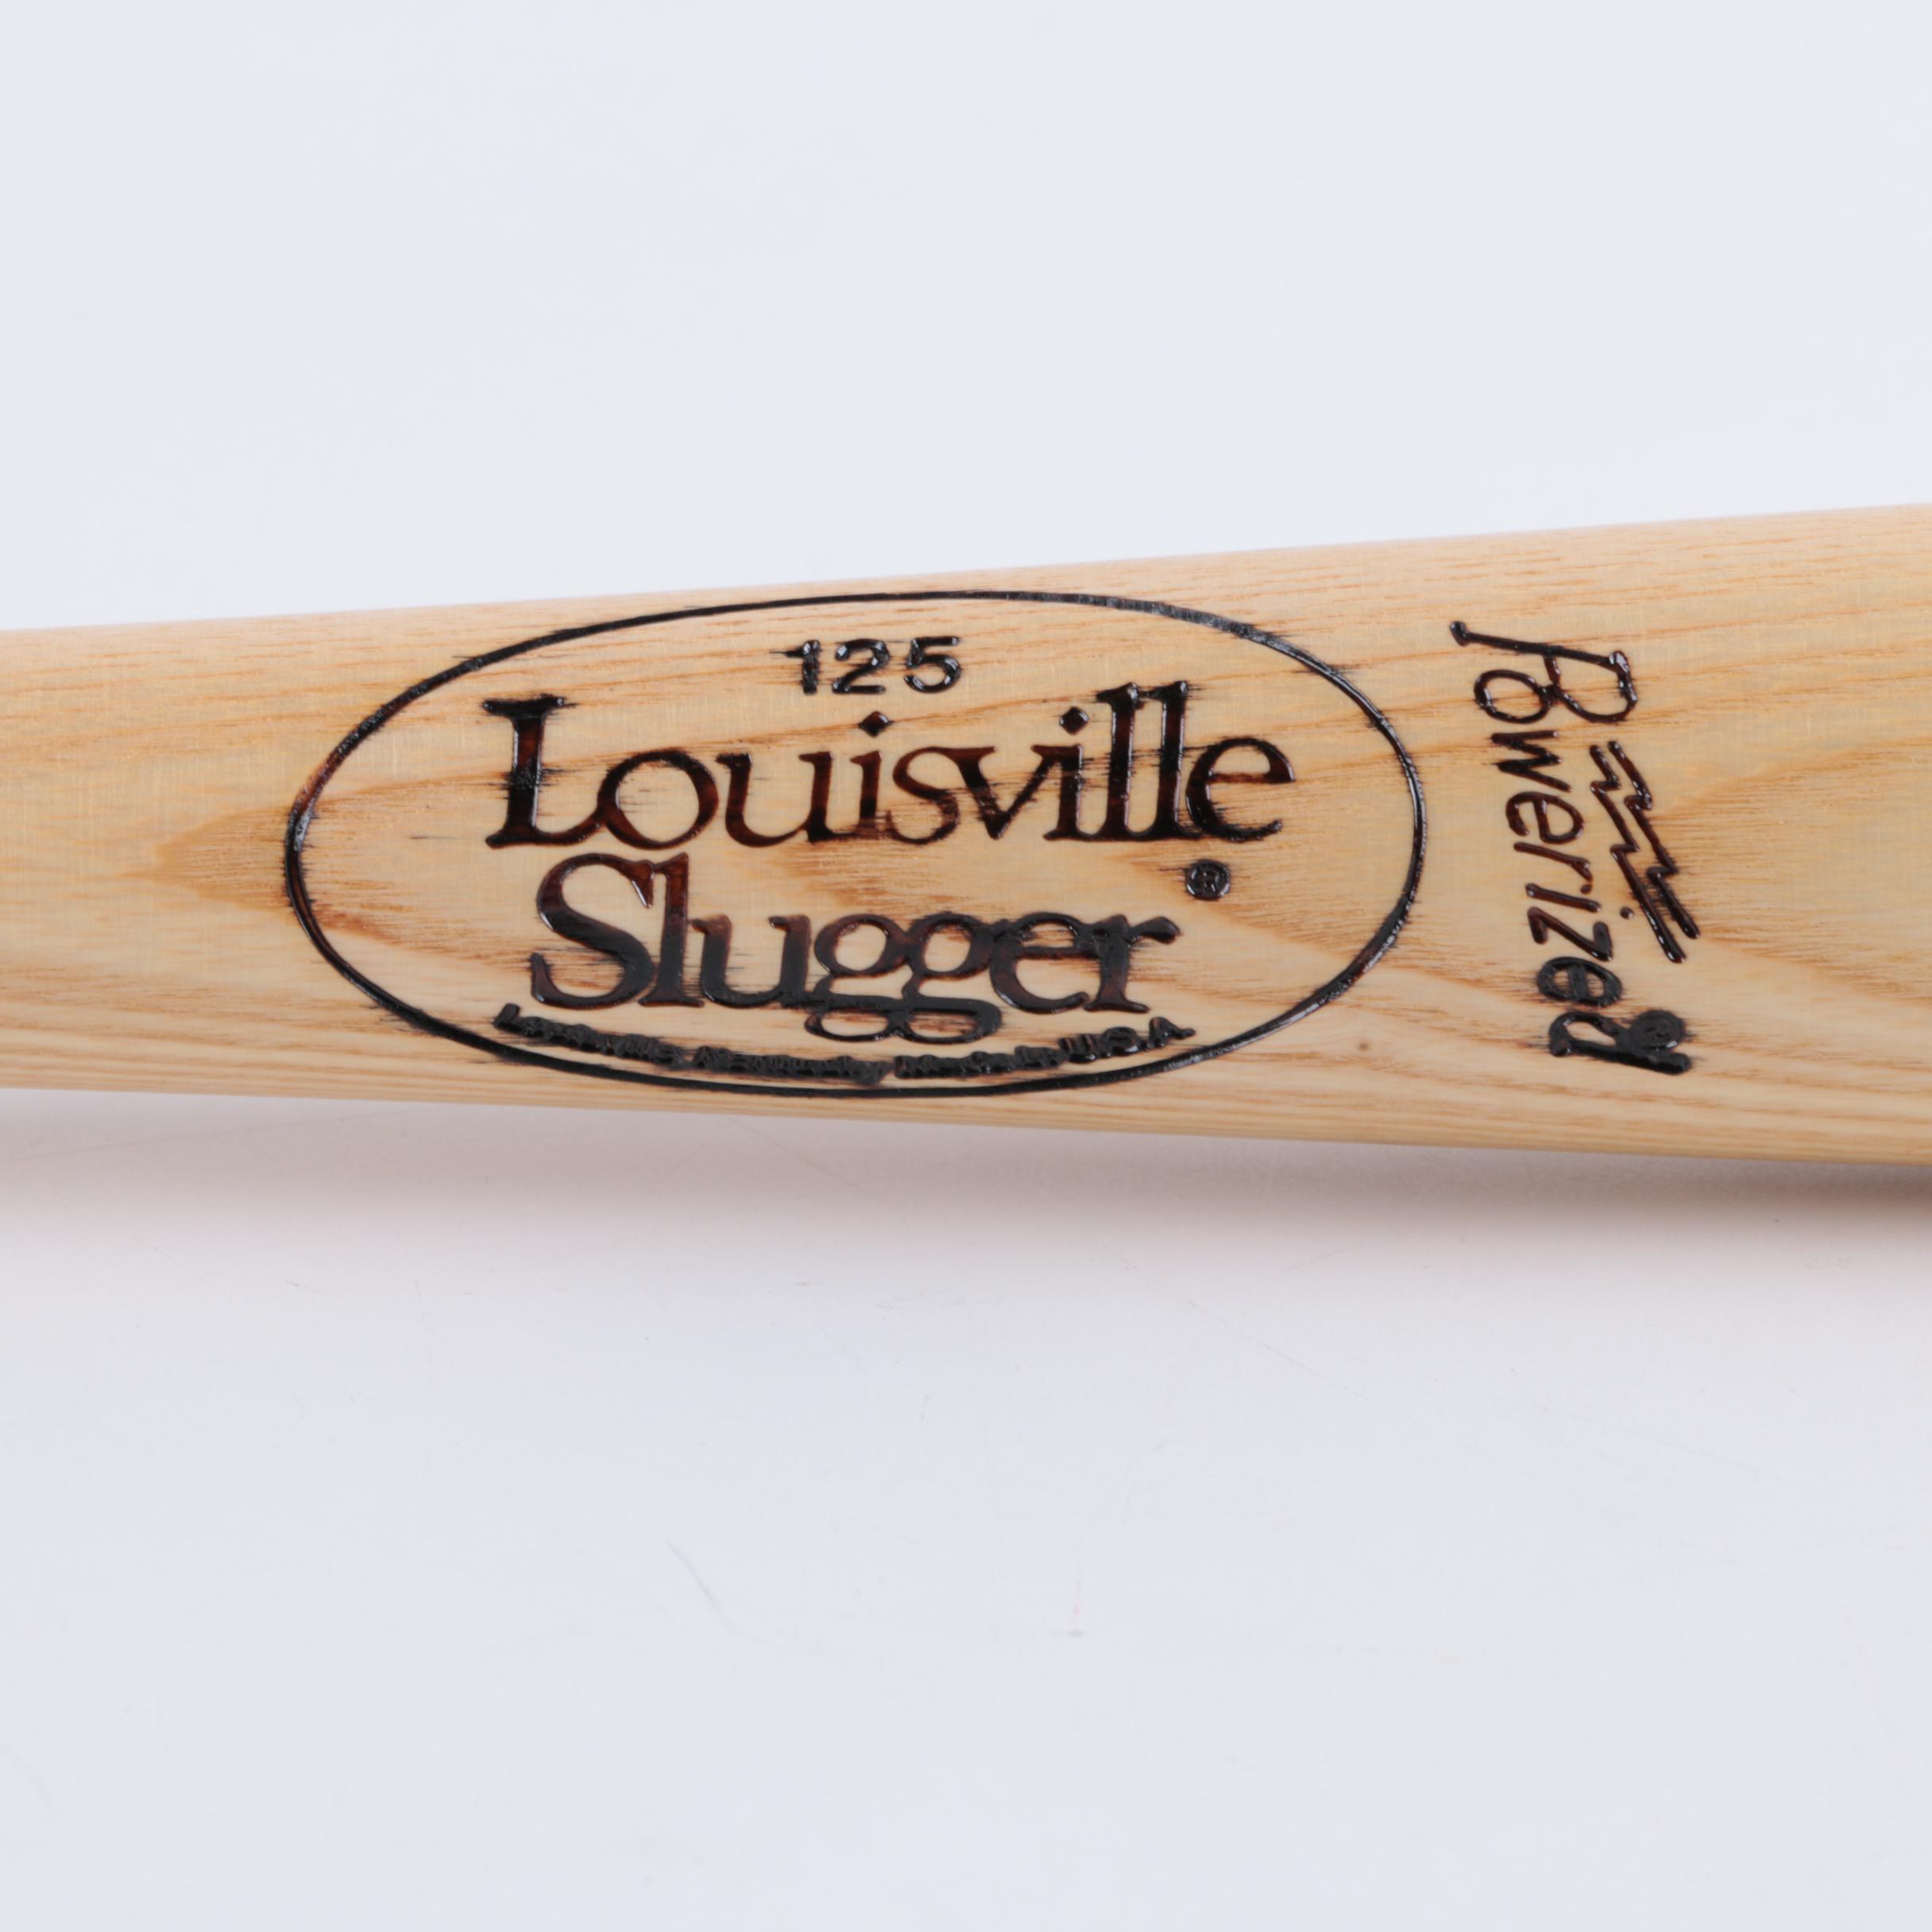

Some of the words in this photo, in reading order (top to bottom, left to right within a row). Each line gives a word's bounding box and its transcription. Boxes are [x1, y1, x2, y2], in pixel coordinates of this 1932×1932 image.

[788, 636, 960, 694] 125
[481, 680, 1296, 849] Louisville
[1449, 620, 1692, 1075] Powerized
[530, 852, 1180, 1043] Slugger
